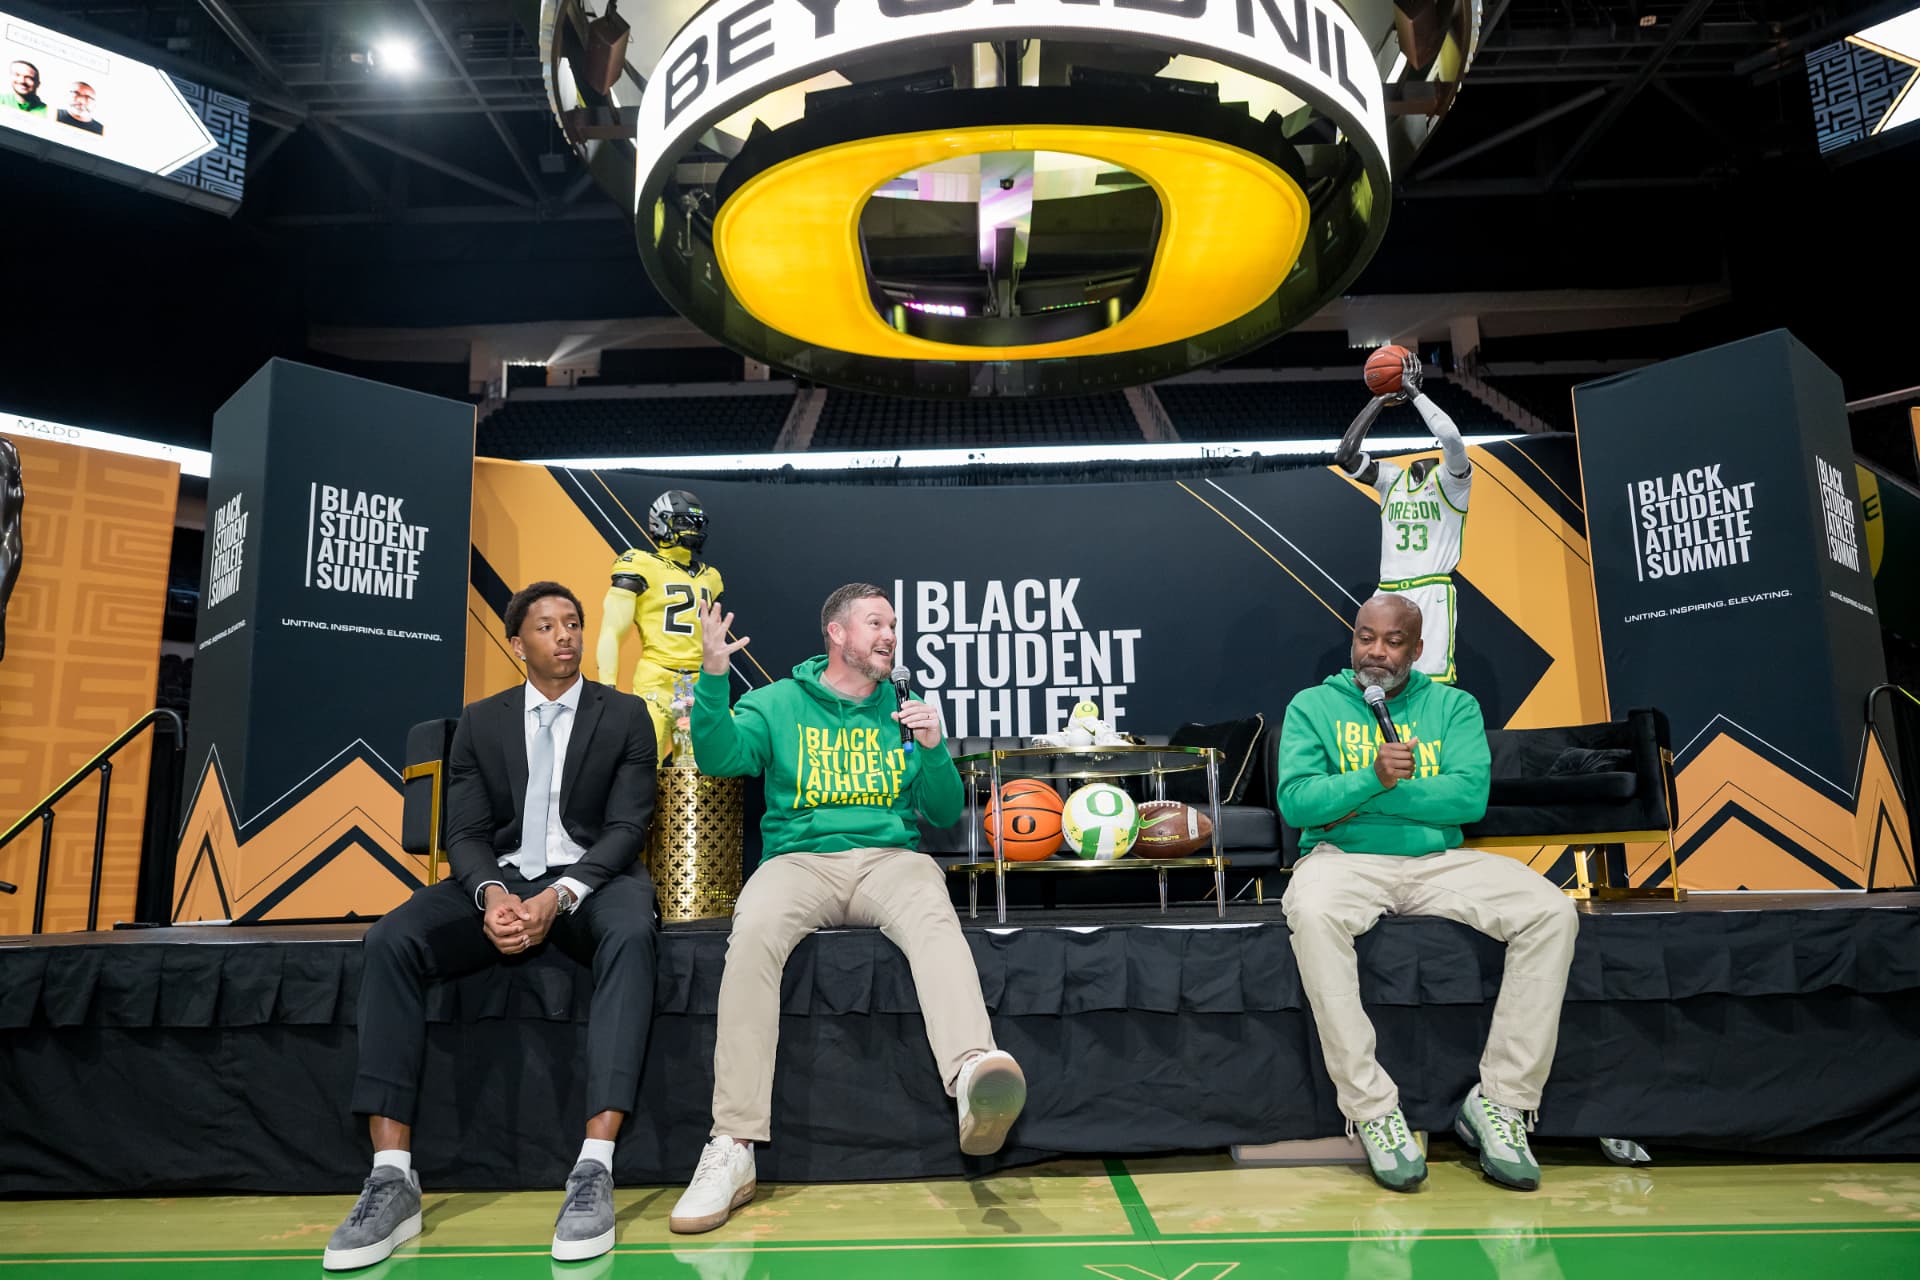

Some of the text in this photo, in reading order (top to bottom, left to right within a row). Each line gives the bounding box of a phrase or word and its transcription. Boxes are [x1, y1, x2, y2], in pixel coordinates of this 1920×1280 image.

[1237, 0, 1367, 112] NIL
[1638, 463, 1724, 506] BLACK
[1818, 457, 1845, 497] BLACK
[217, 492, 242, 532] BLACK
[321, 485, 405, 523] BLACK
[1388, 501, 1441, 522] OREGON
[1641, 482, 1755, 530] STUDENT
[1822, 484, 1855, 524] STUDENT
[215, 511, 248, 557] STUDENT
[319, 511, 429, 551] STUDENT
[1396, 524, 1428, 551] 33
[1645, 510, 1753, 555] ATHLETE
[1827, 509, 1858, 548] ATHLETE
[213, 540, 244, 582] ATHLETE
[317, 537, 421, 575] ATHLETE
[1647, 536, 1752, 579] SUMMIT
[1830, 535, 1860, 573] SUMMIT
[210, 566, 242, 607] SUMMIT
[316, 563, 418, 600] SUMMIT
[916, 578, 1084, 632] BLACK
[1624, 589, 1793, 623] UNITING. INSPIRING. ELEVATING.
[282, 618, 443, 642] UNITING. INSPIRING. ELEVATING.
[915, 629, 1142, 689] STUDENT
[806, 726, 881, 751] BLACK
[807, 748, 906, 774] STUDENT
[1012, 815, 1036, 835] O
